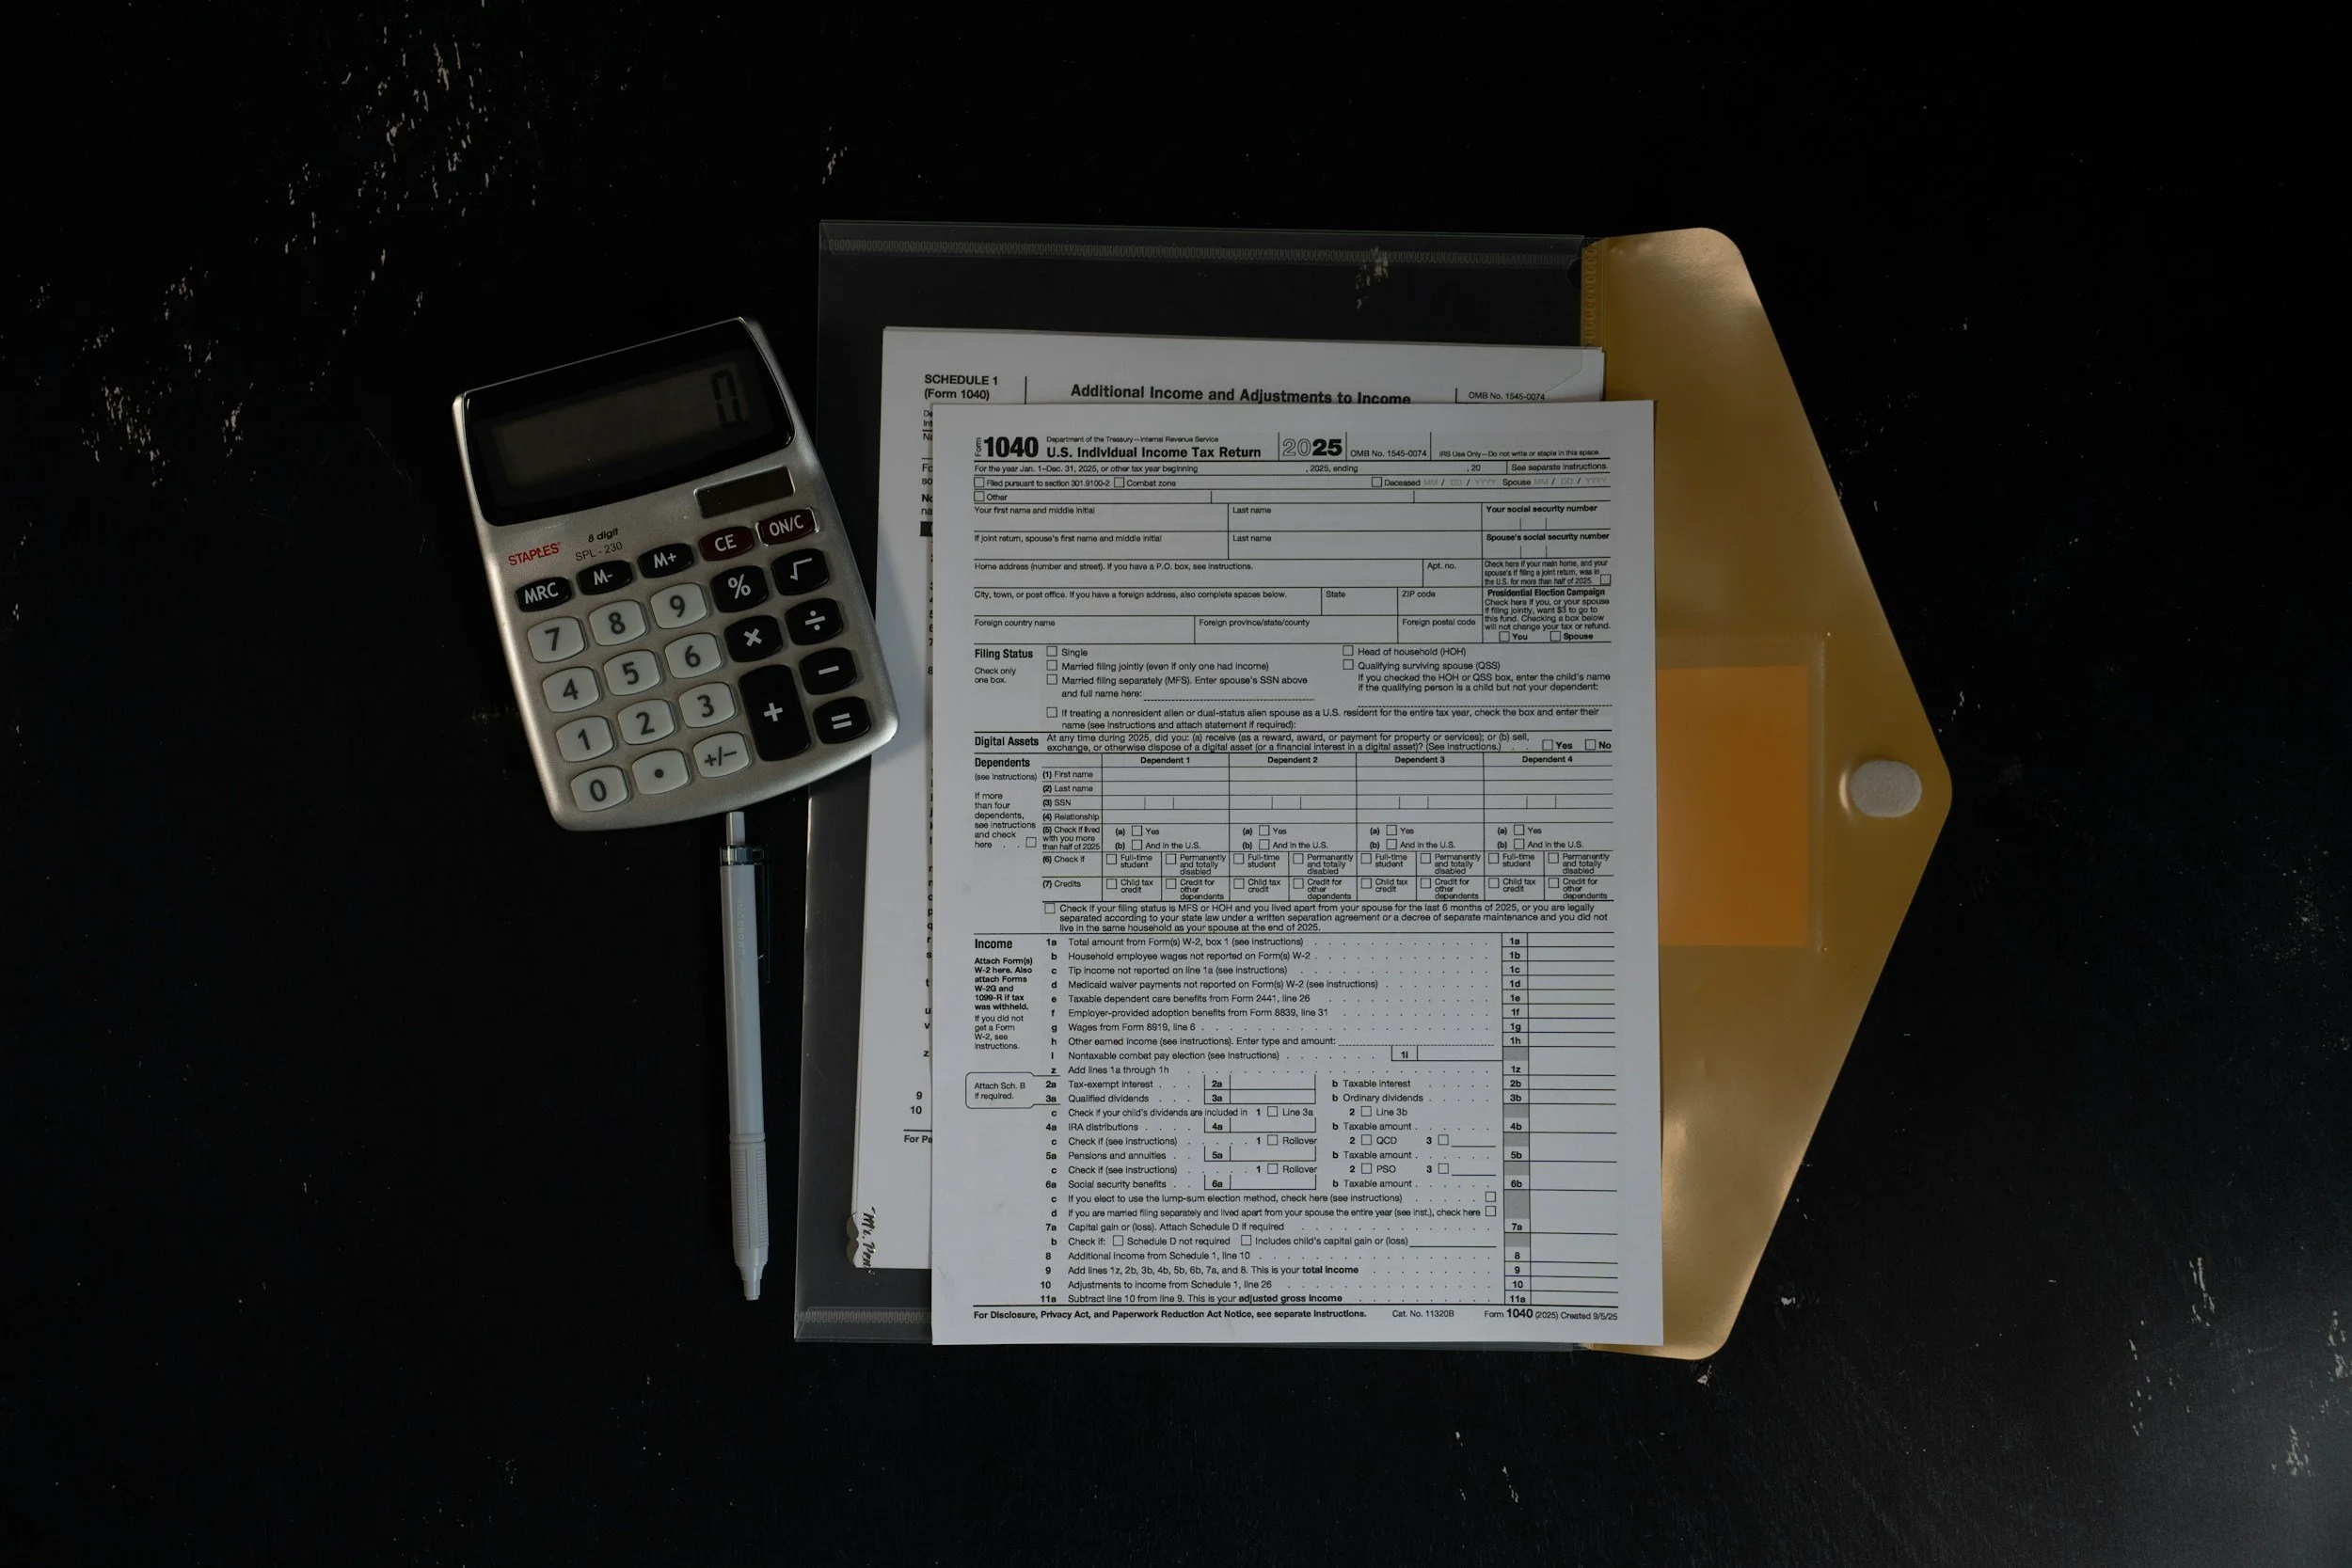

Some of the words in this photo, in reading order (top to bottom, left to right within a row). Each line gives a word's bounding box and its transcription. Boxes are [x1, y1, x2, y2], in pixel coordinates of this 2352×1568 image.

[924, 373, 990, 386] SCHEDULE
[993, 376, 997, 386] 1
[924, 388, 957, 400] (Form
[961, 389, 990, 402] 1040)
[1071, 384, 1144, 399] Additional
[1150, 387, 1203, 400] Income
[1208, 388, 1234, 401] and
[1239, 388, 1332, 404] Adjustments
[1337, 391, 1352, 404] to
[1358, 391, 1411, 404] Income
[984, 436, 1039, 458] 1040
[1046, 446, 1073, 458] U.S.
[1077, 447, 1137, 458] Individual
[1142, 447, 1188, 458] Income
[1191, 446, 1215, 458] Tax
[1219, 446, 1261, 458] Return
[1282, 438, 1343, 457] 2025
[1528, 464, 1561, 472] separate
[1126, 479, 1157, 487] Combat
[986, 493, 1008, 501] Other
[1032, 506, 1047, 515] and
[1048, 506, 1074, 515] middle
[1076, 506, 1095, 515] initial
[1533, 504, 1565, 514] security
[770, 516, 803, 535] ON/C
[588, 533, 595, 543] 8
[596, 527, 619, 541] digit
[1486, 533, 1522, 542] Spouse's
[1548, 532, 1579, 542] security
[715, 533, 737, 552] CE
[654, 551, 677, 569] M+
[594, 569, 613, 586] M-
[728, 574, 752, 600] %
[1487, 589, 1533, 597] Presidential
[1534, 588, 1565, 596] Election
[1566, 587, 1605, 597] Campaign
[524, 582, 559, 605] MRC
[1326, 590, 1345, 598] State
[669, 594, 686, 618] 9
[608, 611, 626, 635] 8
[975, 619, 1003, 628] Foreign
[1004, 619, 1033, 628] country
[544, 626, 561, 651] 7
[685, 645, 702, 668] 6
[975, 648, 1001, 660] Filing
[1003, 648, 1033, 658] Status
[1061, 647, 1088, 658] Single
[1358, 647, 1381, 657] Head
[1383, 647, 1392, 657] of
[1393, 647, 1438, 657] household
[1439, 647, 1467, 658] (HOH)
[623, 662, 640, 685] 5
[563, 679, 580, 700] 4
[698, 695, 715, 718] 3
[636, 712, 655, 735] 2
[578, 728, 591, 751] 1
[975, 736, 1005, 749] Digital
[1008, 736, 1039, 747] Assets
[975, 757, 1030, 769] Dependents
[1140, 756, 1184, 766] Dependent
[1267, 756, 1311, 765] Dependent
[1394, 756, 1438, 765] Dependent
[1439, 755, 1445, 764] 3
[1522, 755, 1565, 764] Dependent
[589, 779, 607, 802] 0
[975, 939, 1012, 949] Income
[1046, 938, 1057, 946] 1a
[1068, 938, 1089, 946] Total
[1091, 938, 1124, 946] amount
[1126, 937, 1146, 946] from
[1148, 937, 1181, 947] Form(s)
[1182, 937, 1203, 946] W-2,
[1205, 938, 1222, 946] box
[1232, 937, 1249, 947] (see
[1251, 937, 1304, 947] instructions)
[1509, 937, 1520, 945] 1a
[925, 1006, 931, 1016] u
[924, 1022, 930, 1030] v
[916, 1091, 923, 1101] 9
[911, 1105, 922, 1115] 10
[903, 1134, 920, 1143] For
[1511, 1223, 1522, 1231] 7a
[1509, 1294, 1526, 1304] 11a
[990, 1310, 1038, 1320] Disclosure,
[1041, 1310, 1073, 1320] Privacy
[1073, 1310, 1091, 1320] Act,
[1093, 1310, 1110, 1319] and
[1112, 1309, 1159, 1320] Paperwork
[1161, 1309, 1204, 1319] Reduction
[1206, 1309, 1222, 1318] Act
[1224, 1309, 1254, 1319] Notice,
[1274, 1310, 1311, 1319] separate
[1313, 1309, 1367, 1318] instructions.
[1392, 1309, 1407, 1318] Cat.
[1425, 1309, 1454, 1318] 11320B
[1484, 1310, 1504, 1319] Form
[1506, 1307, 1534, 1319] 1040
[1535, 1311, 1559, 1321] (2025)
[1560, 1311, 1592, 1320] Created
[1593, 1312, 1618, 1321] 9/5/25
